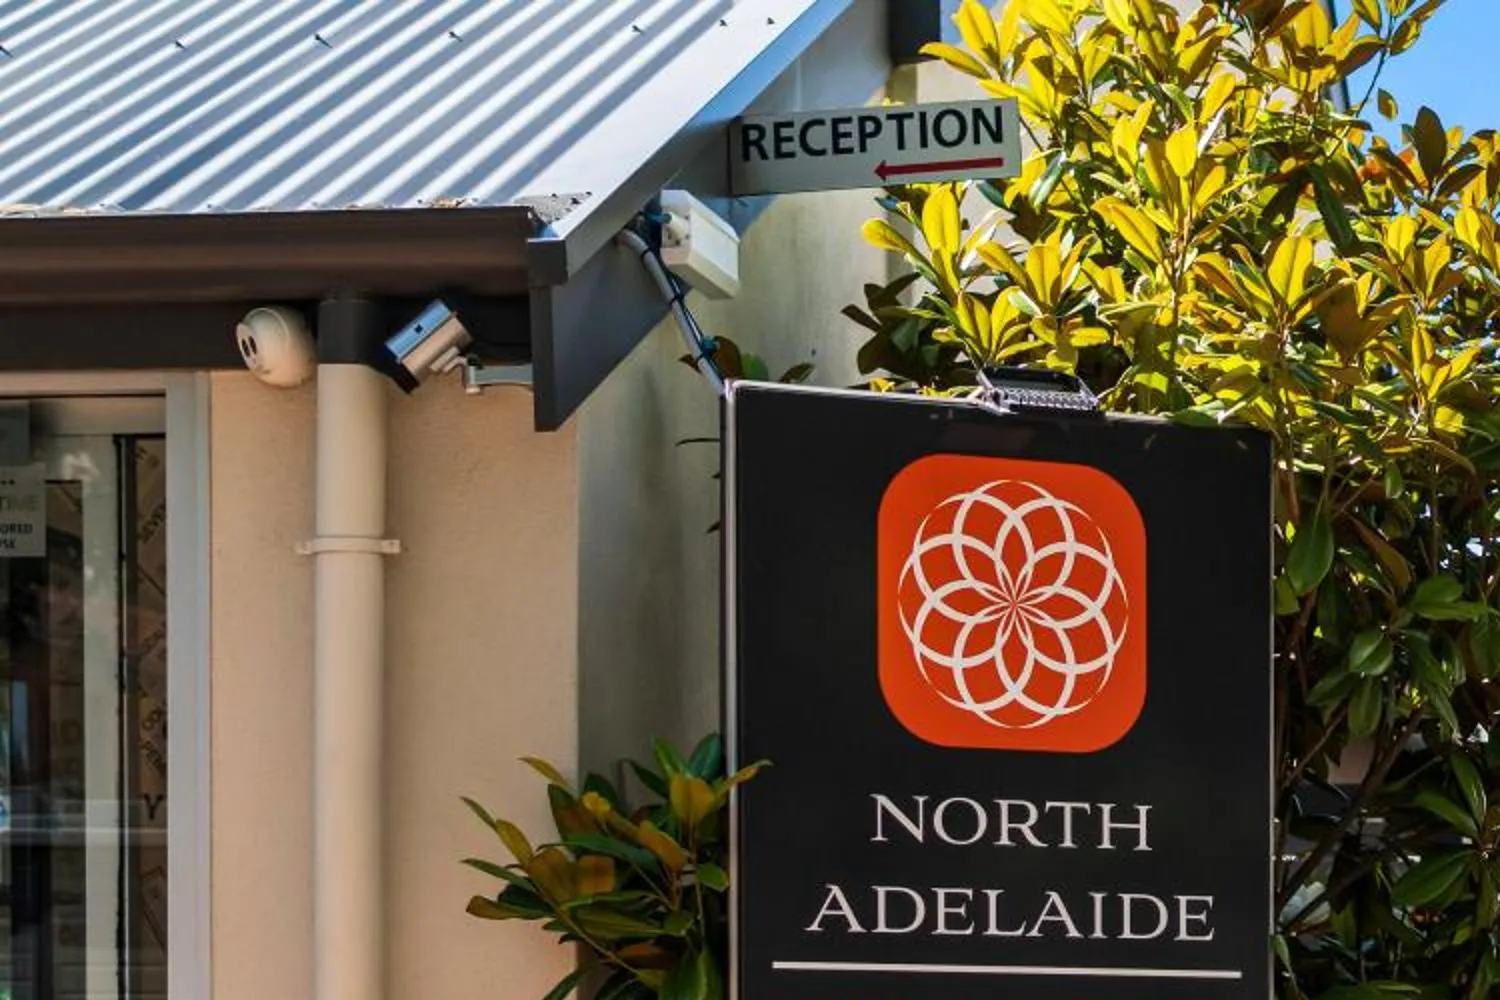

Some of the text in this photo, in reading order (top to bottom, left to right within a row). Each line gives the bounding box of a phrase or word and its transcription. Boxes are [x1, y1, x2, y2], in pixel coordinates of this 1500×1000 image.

[740, 106, 1004, 162] RECEPTION
[871, 793, 1153, 851] NORTH
[804, 883, 1215, 941] ADELAIDE
